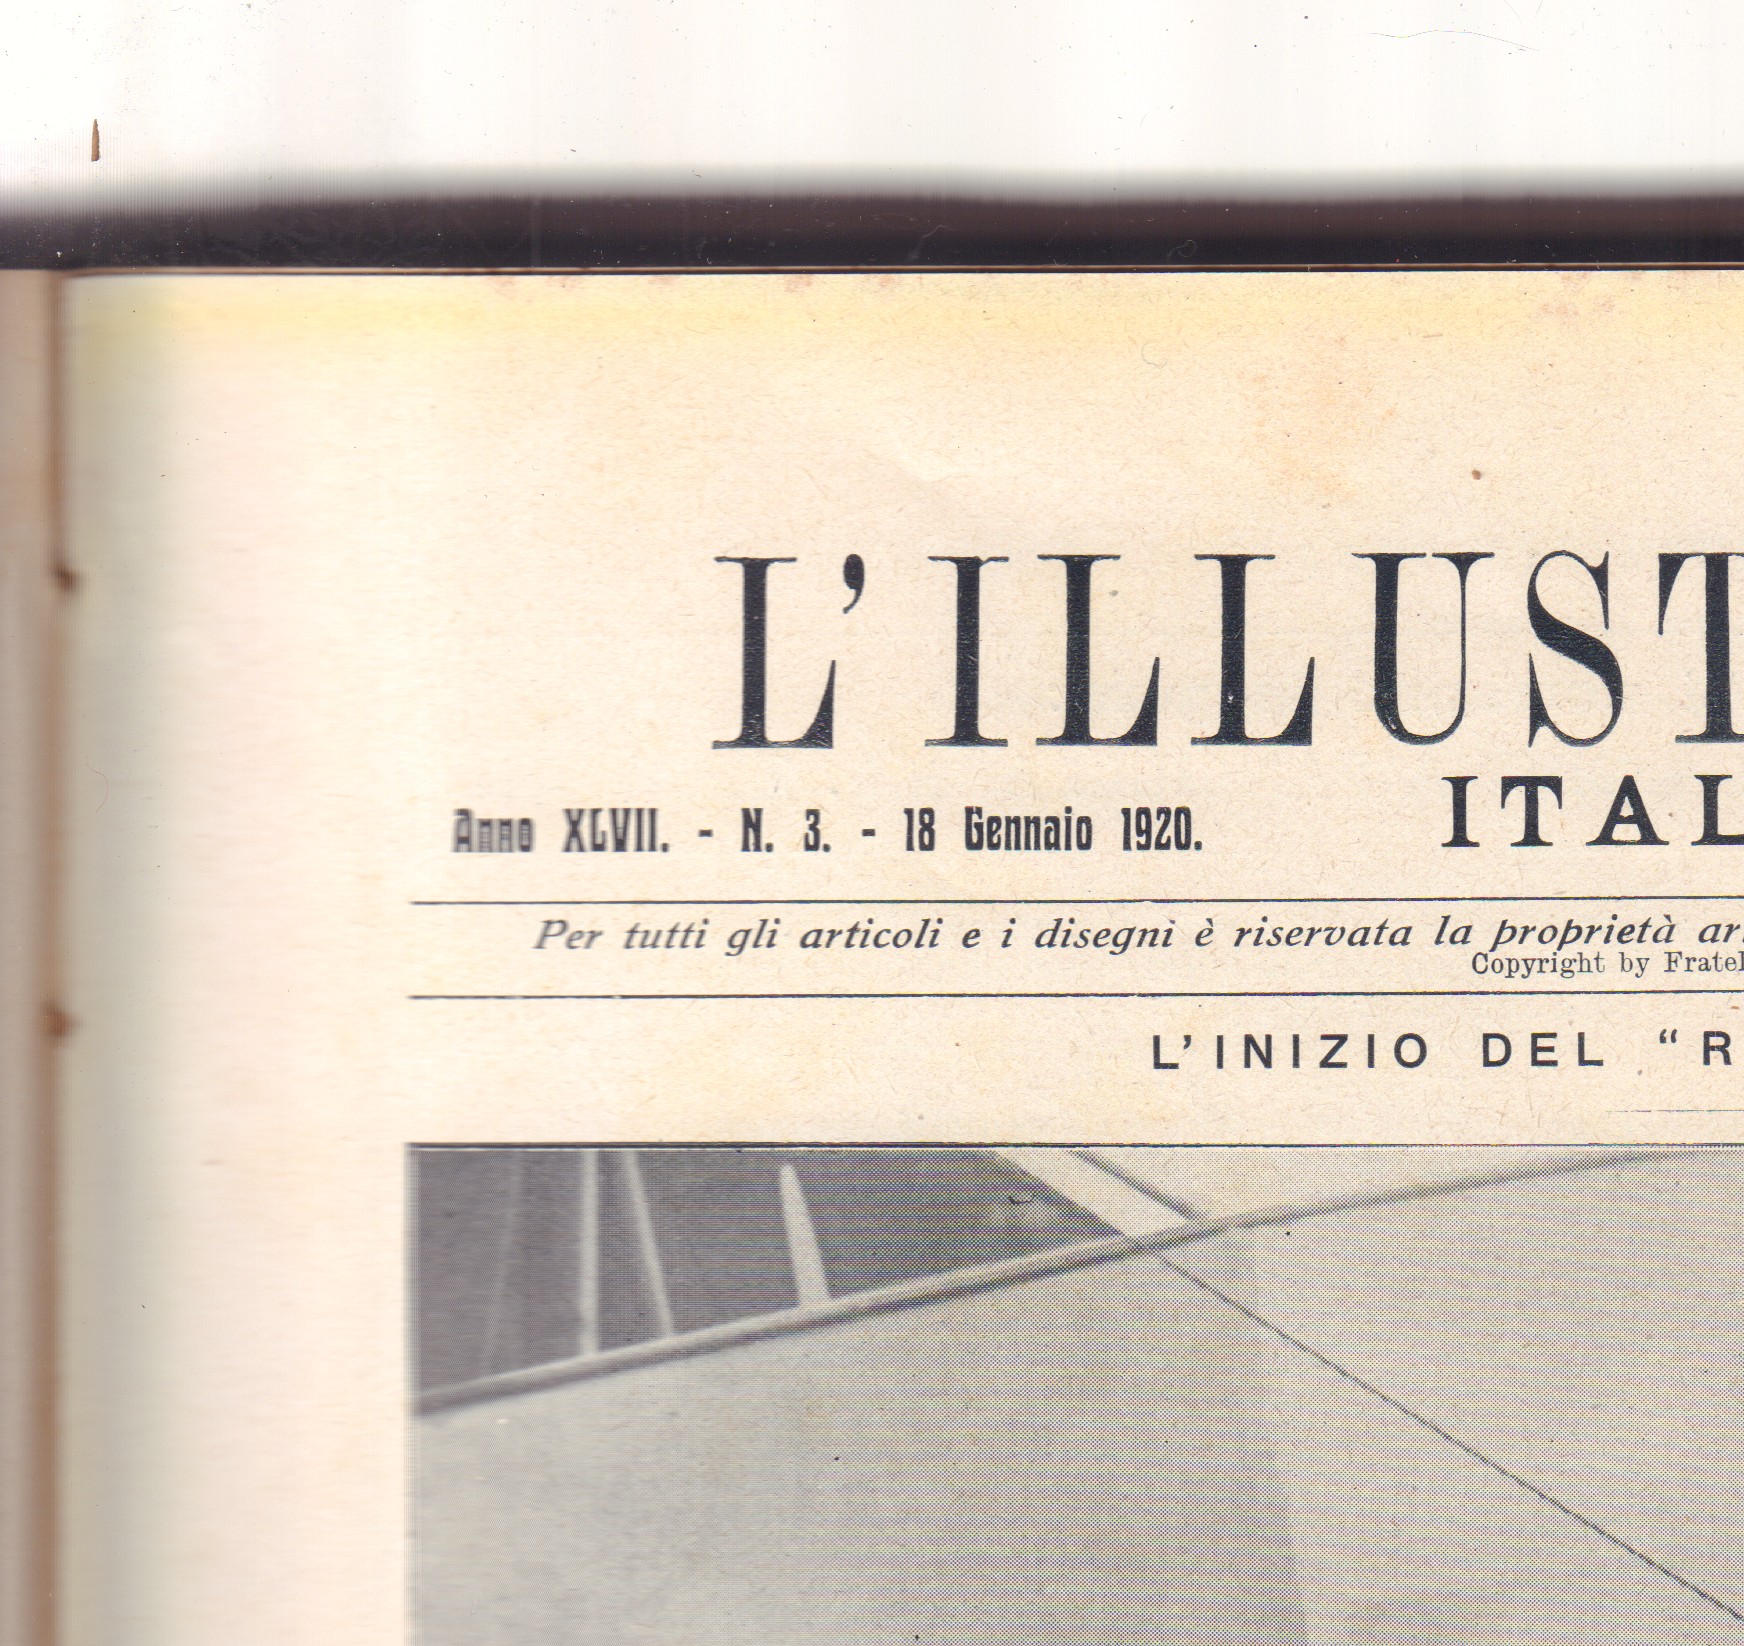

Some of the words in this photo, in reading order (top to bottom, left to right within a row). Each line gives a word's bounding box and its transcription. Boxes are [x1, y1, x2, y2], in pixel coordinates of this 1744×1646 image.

[453, 807, 535, 854] Anno
[562, 807, 669, 853] XLVII.
[741, 807, 774, 853] N.
[804, 808, 831, 853] 3.
[903, 807, 936, 852] 18
[964, 805, 1093, 851] Gennaio
[1120, 805, 1203, 852] 1920.
[534, 918, 603, 951] Per
[625, 918, 709, 950] tutti
[725, 917, 780, 957] gli
[799, 917, 944, 949] articoli
[961, 928, 981, 949] e
[1001, 917, 1016, 949] i
[1034, 917, 1176, 956] disegni
[1194, 917, 1214, 947] è
[1233, 915, 1413, 947] riservata
[1434, 914, 1473, 946] la
[1488, 913, 1676, 953] proprietà
[1471, 951, 1605, 979] Copyright
[1618, 951, 1650, 979] by
[1482, 1031, 1604, 1068] DEL
